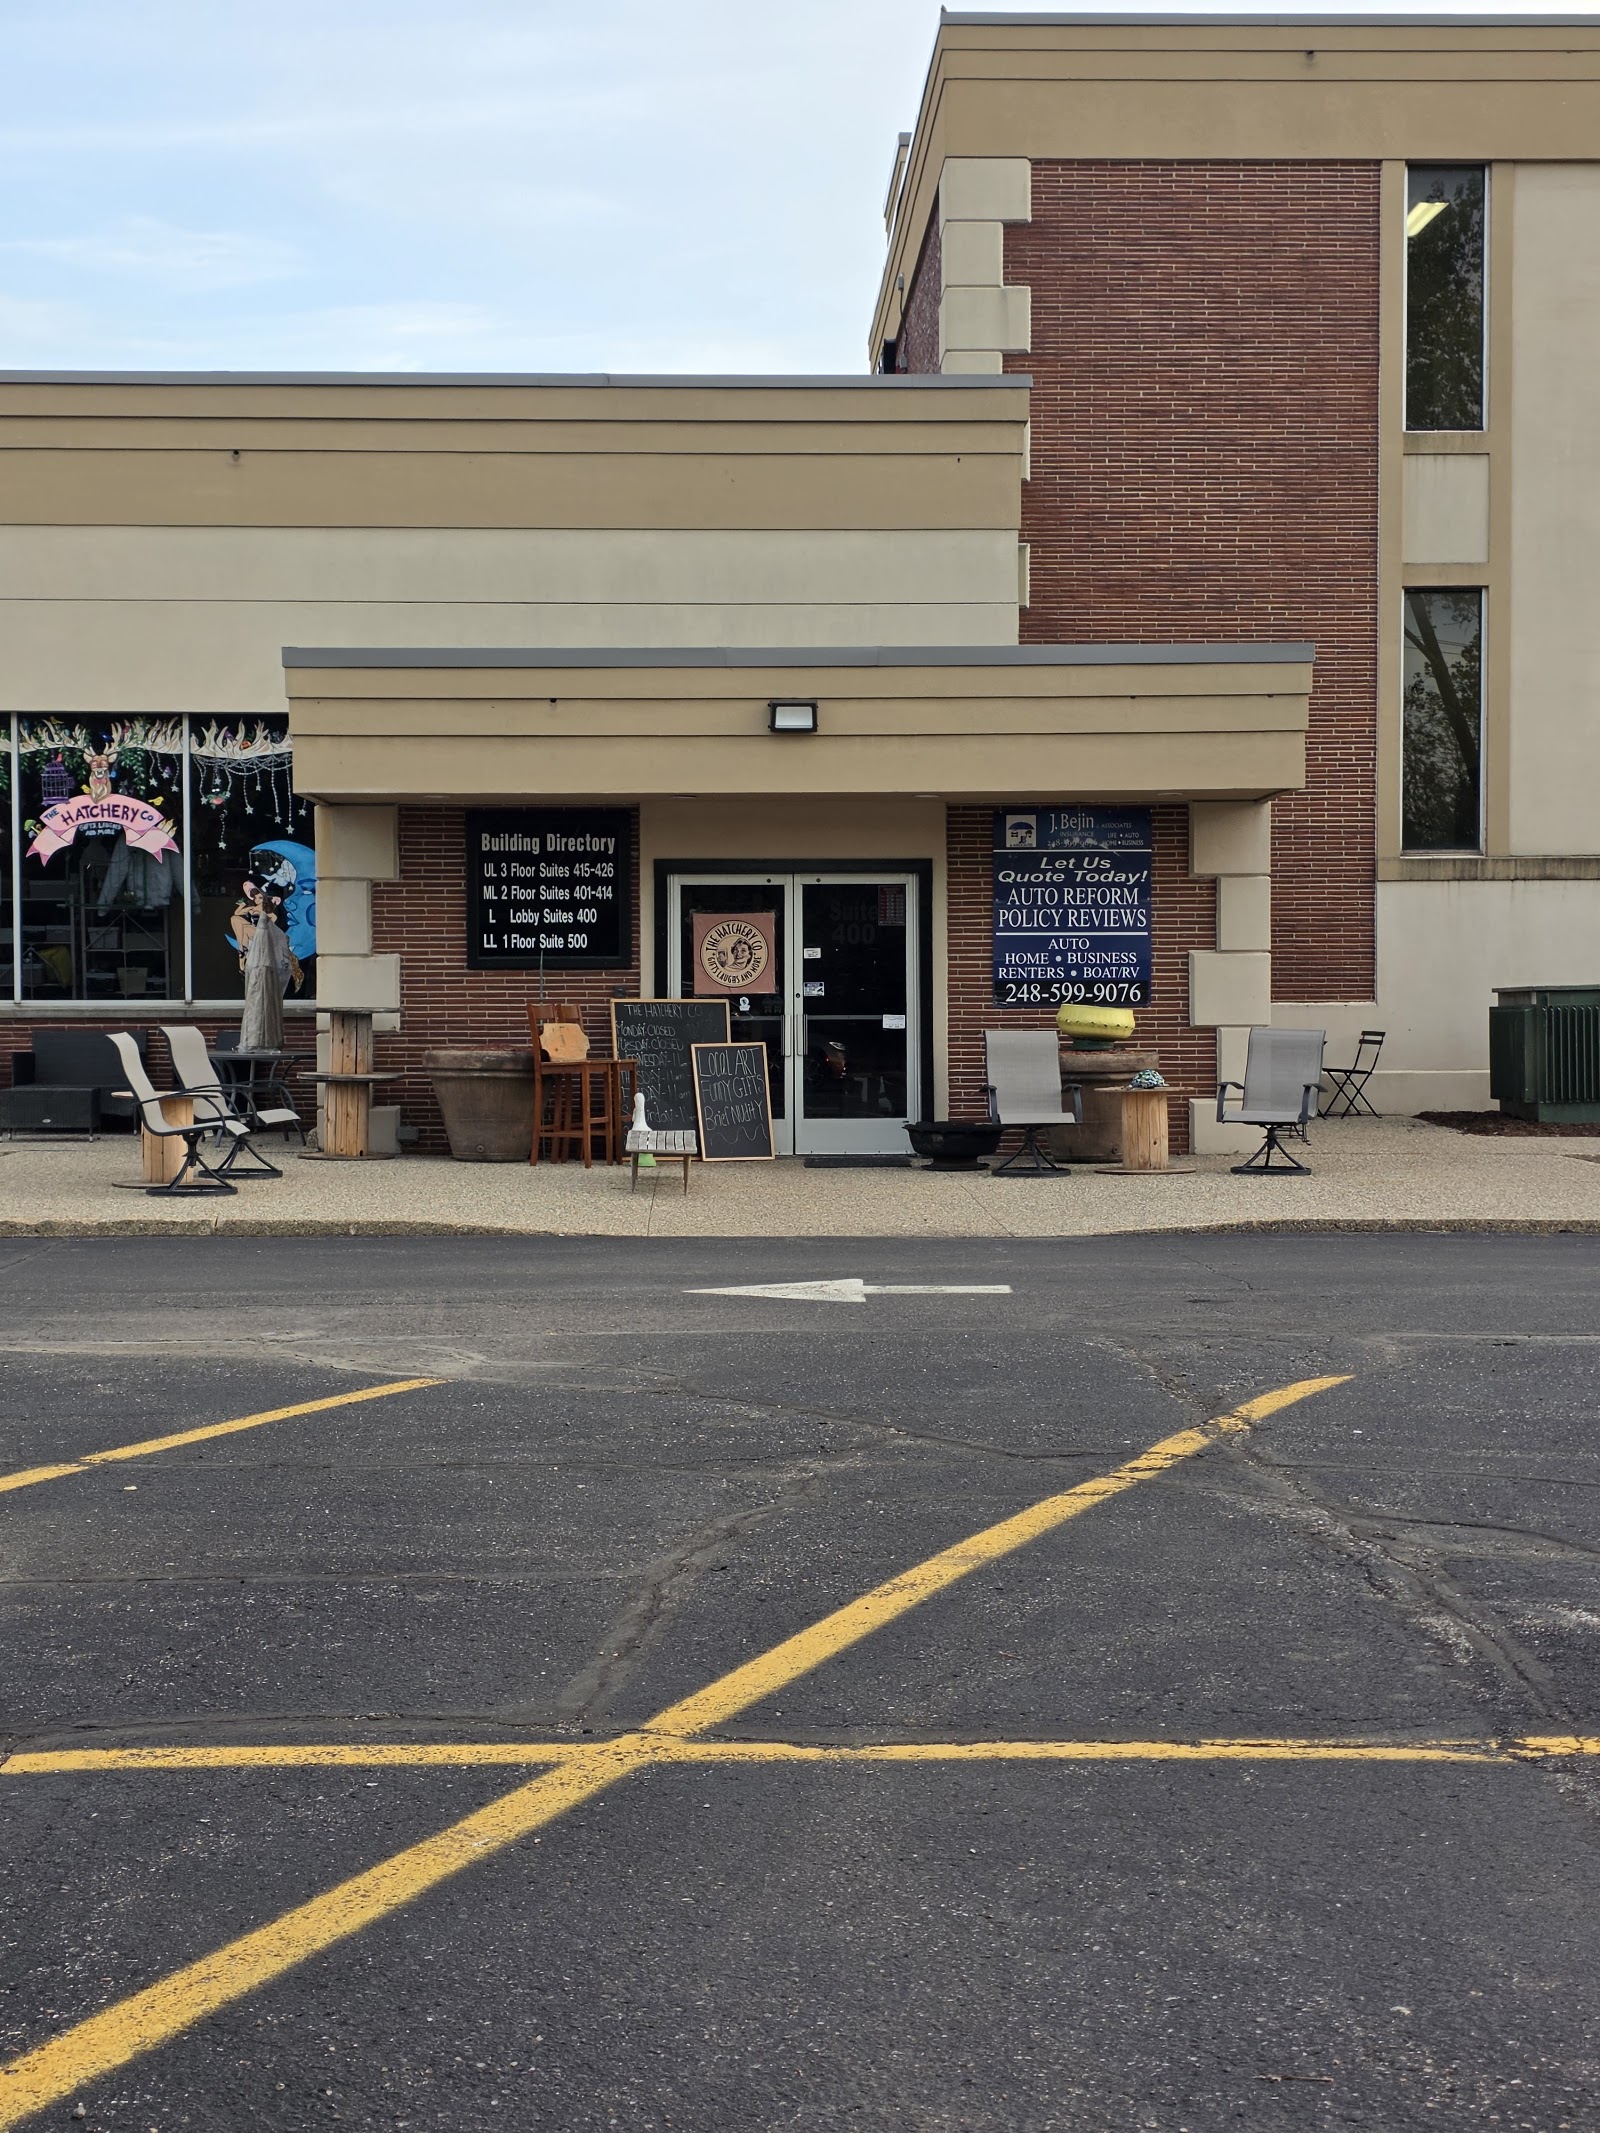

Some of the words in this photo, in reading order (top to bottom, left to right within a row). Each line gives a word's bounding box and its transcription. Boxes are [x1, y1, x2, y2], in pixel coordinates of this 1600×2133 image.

[44, 808, 60, 821] THE
[61, 803, 139, 826] HATCHERY
[1049, 813, 1059, 833] J.
[1060, 813, 1094, 833] Bejin
[481, 833, 540, 854] Building
[546, 833, 616, 854] Directory
[484, 863, 497, 877] UL
[500, 863, 507, 877] 3
[510, 863, 536, 877] Floor
[539, 863, 570, 877] Suites
[573, 863, 614, 877] 415-426
[1040, 857, 1076, 869] Let
[1082, 857, 1112, 869] Us
[998, 870, 1065, 883] Quote
[1074, 870, 1148, 885] Today!
[483, 885, 498, 900] ML
[501, 885, 508, 900] 2
[511, 885, 536, 900] Floor
[539, 885, 570, 900] Suites
[573, 885, 613, 900] 401-414
[1007, 887, 1058, 905] AUTO
[1063, 887, 1139, 905] REFORM
[489, 909, 496, 923] L
[510, 908, 539, 926] Lobby
[543, 908, 573, 923] Suites
[577, 908, 597, 923] 400
[831, 899, 877, 921] Suite
[998, 909, 1063, 928] POLICY
[1067, 909, 1147, 928] REVIEWS
[483, 934, 497, 948] LL
[503, 934, 508, 948] 1
[511, 934, 536, 948] Floor
[539, 934, 564, 948] Suite
[567, 934, 588, 948] 500
[705, 934, 720, 952] THE
[715, 923, 758, 941] HATCHERY
[751, 940, 763, 951] CO
[831, 922, 876, 945] 400
[1048, 938, 1090, 950] AUTO
[1005, 952, 1049, 964] HOME
[1067, 952, 1137, 964] BUSINESS
[707, 956, 719, 974] GIFTS
[741, 971, 753, 982] AND
[751, 956, 762, 974] MORE
[998, 967, 1065, 979] RENTERS
[1083, 967, 1140, 980] BOAT/RV
[1005, 983, 1141, 1003] 248-599-9076
[624, 1004, 642, 1016] THE
[644, 1003, 682, 1018] HATCHERY
[687, 1004, 703, 1018] CO
[734, 1047, 760, 1077] ART
[732, 1074, 765, 1099] GIFTS
[703, 1105, 730, 1131] Brief
